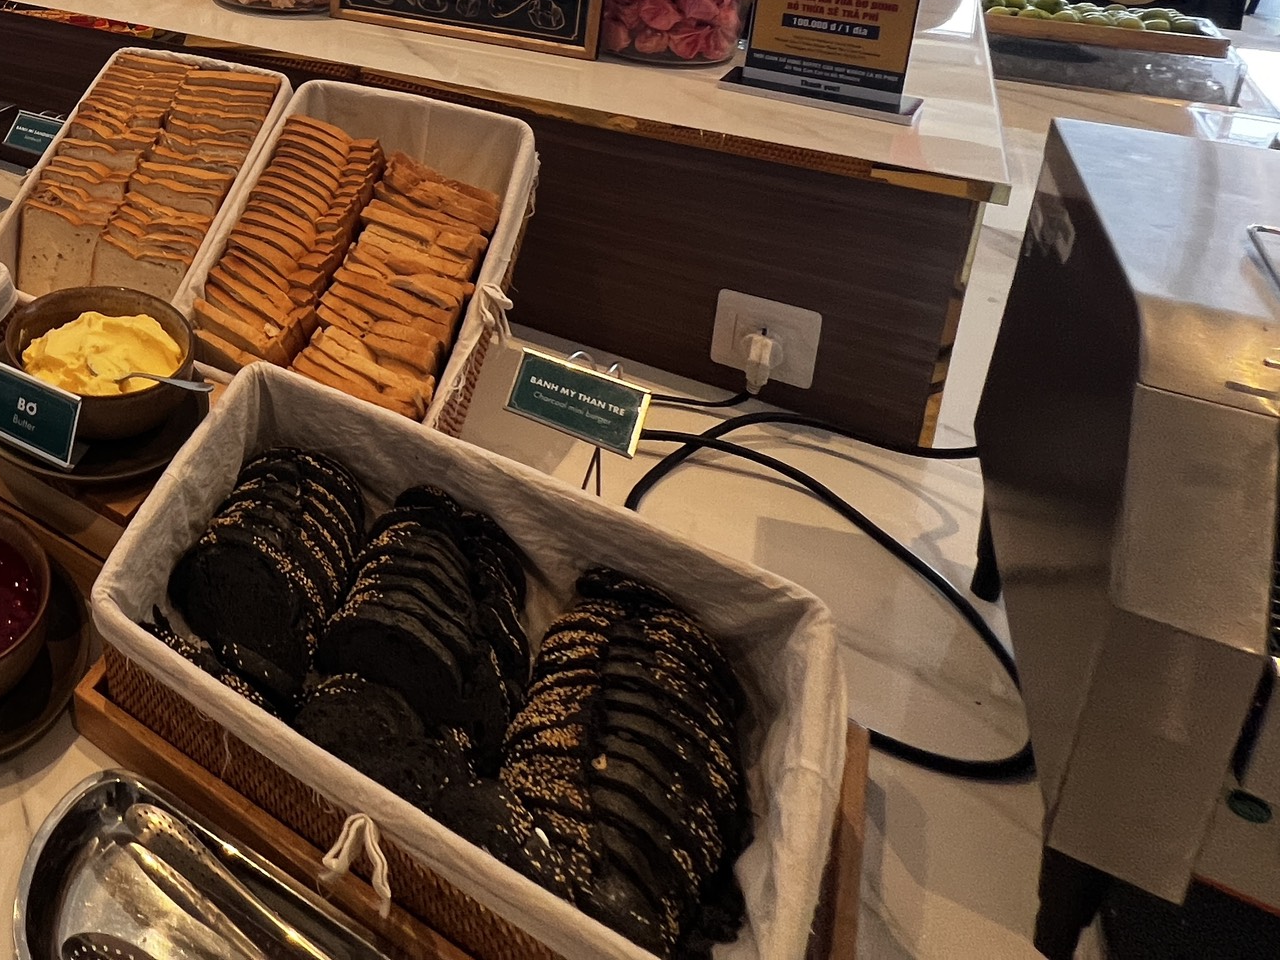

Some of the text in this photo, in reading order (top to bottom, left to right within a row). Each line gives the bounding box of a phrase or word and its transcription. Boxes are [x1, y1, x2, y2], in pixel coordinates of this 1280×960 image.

[792, 17, 828, 29] 100.000
[17, 397, 37, 416] BƠ
[578, 392, 607, 409] THAN
[607, 403, 626, 416] TRE
[12, 413, 36, 432] Butter
